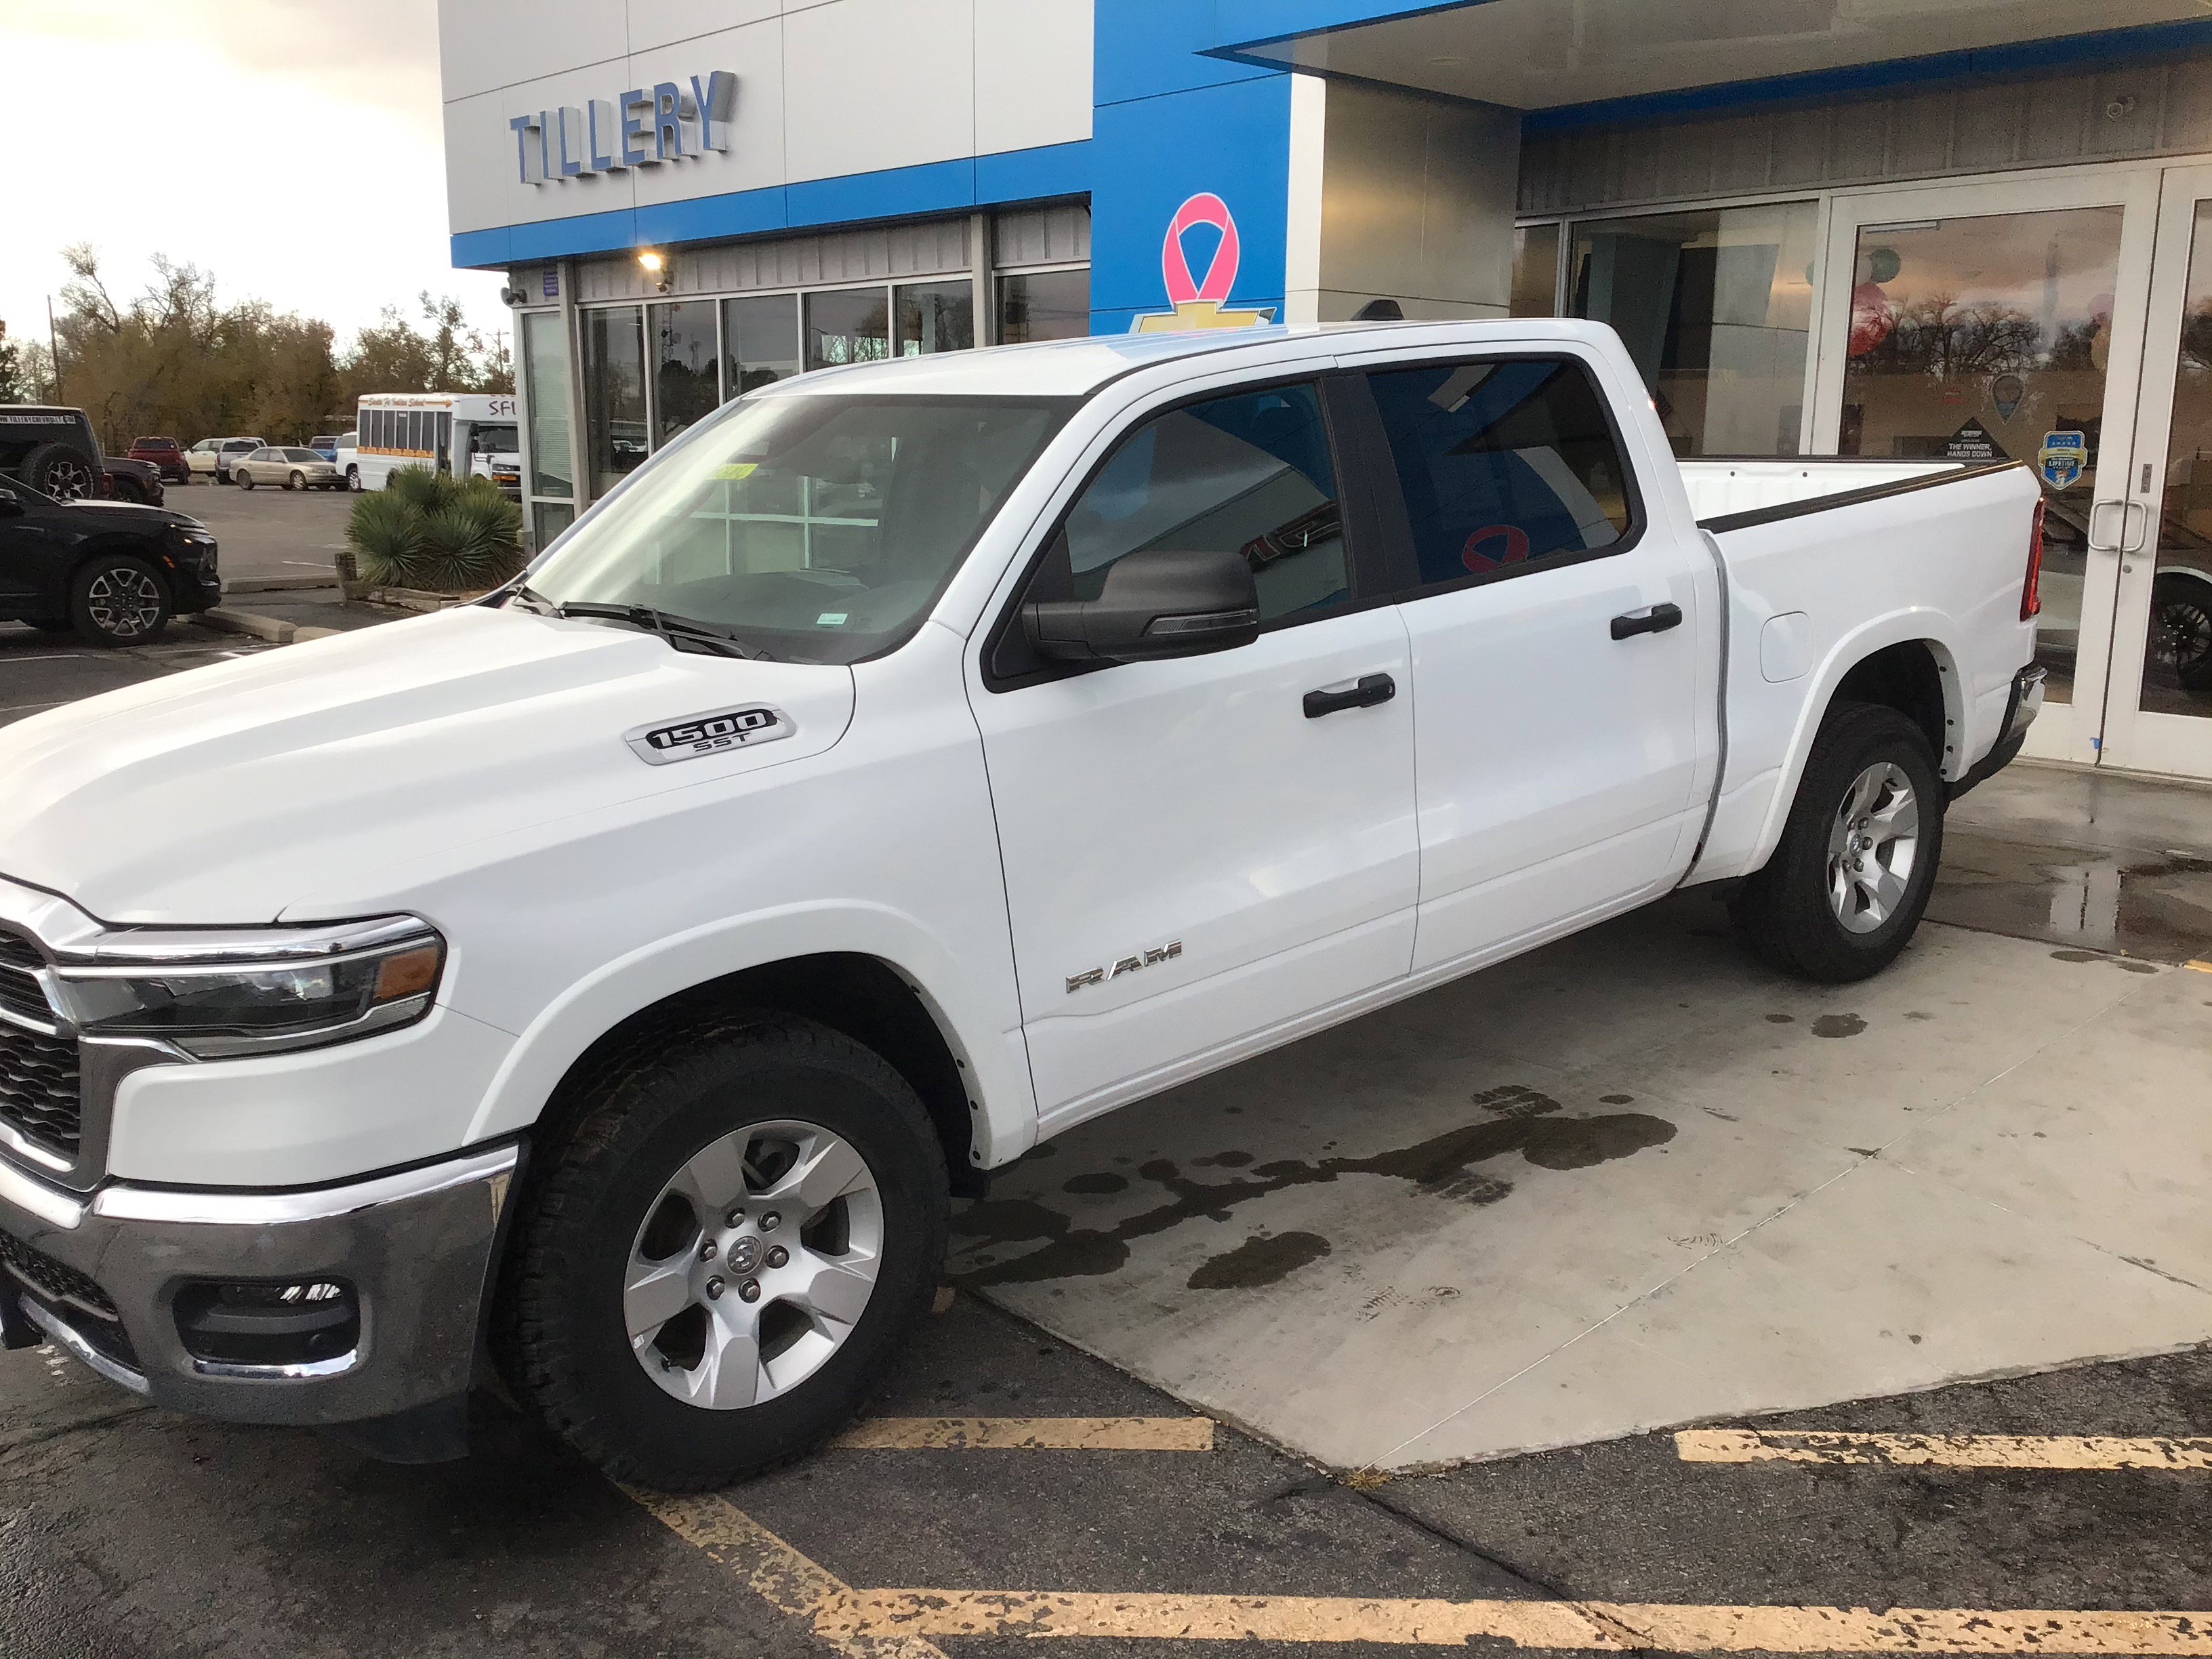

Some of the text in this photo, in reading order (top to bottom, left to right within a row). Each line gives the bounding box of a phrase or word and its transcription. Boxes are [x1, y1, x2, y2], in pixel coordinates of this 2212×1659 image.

[510, 70, 729, 184] TILLERY
[653, 712, 766, 747] 1500
[693, 732, 752, 752] SST
[1066, 939, 1182, 994] RAM
